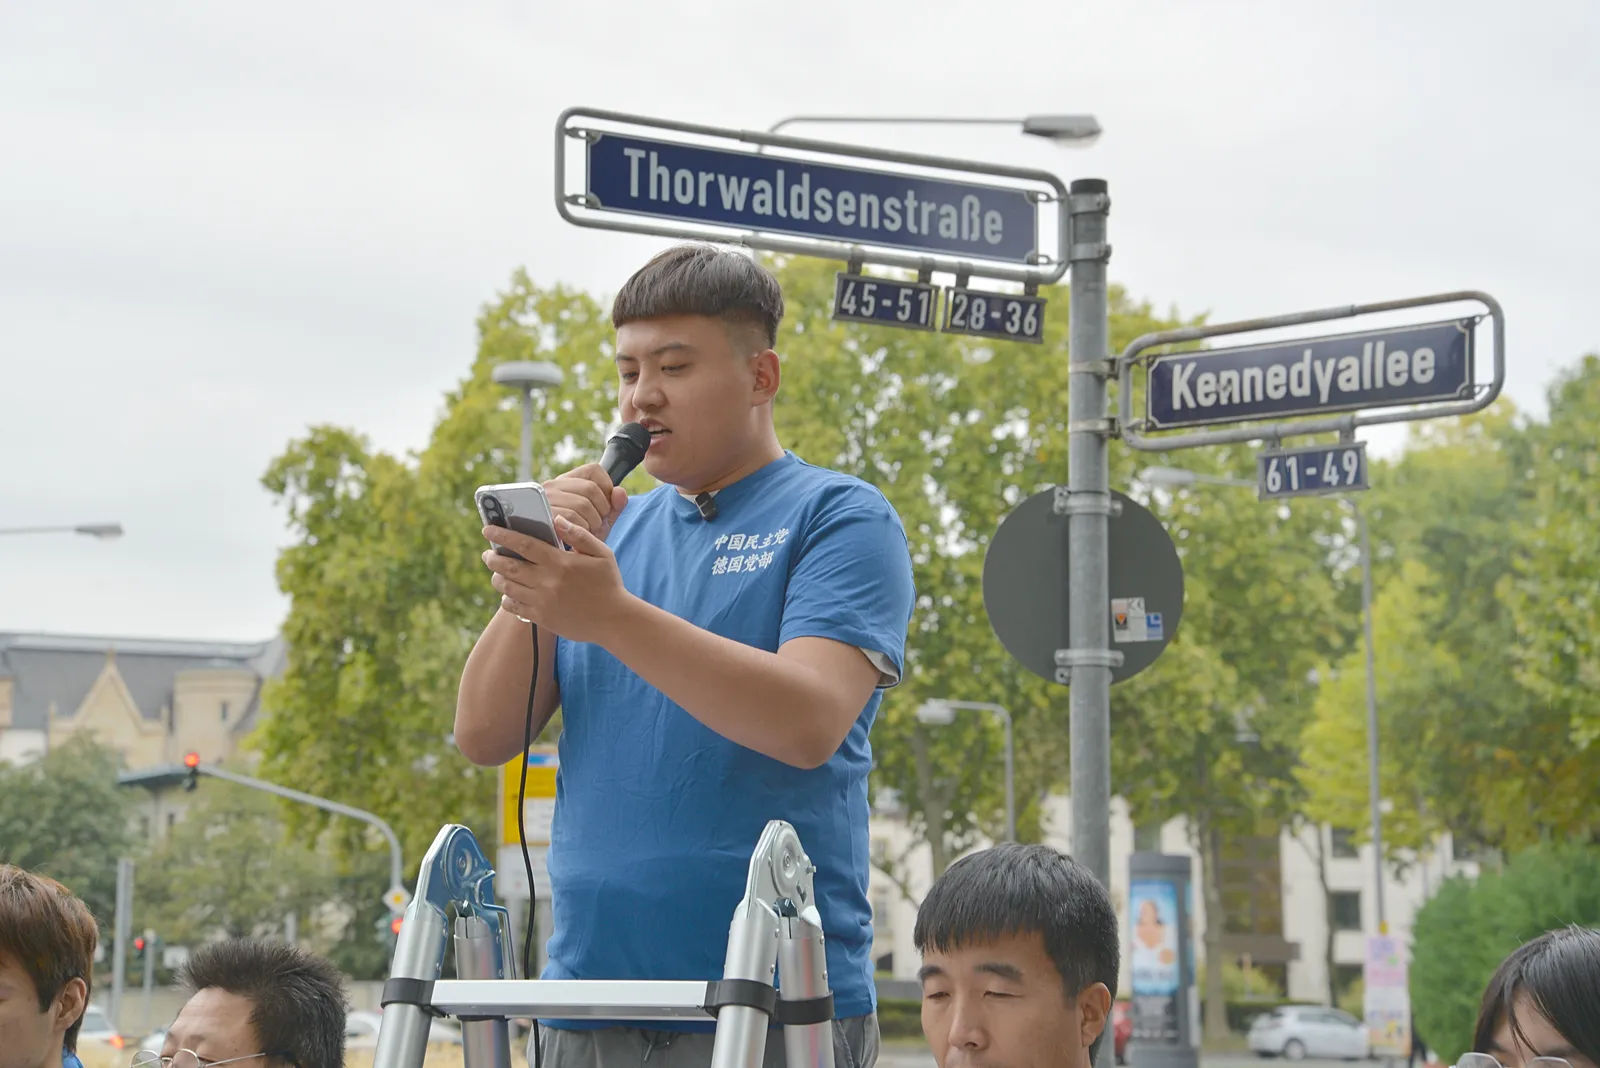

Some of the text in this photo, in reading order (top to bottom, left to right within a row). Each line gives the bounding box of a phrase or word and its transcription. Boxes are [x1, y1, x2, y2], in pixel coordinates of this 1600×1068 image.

[623, 148, 1003, 244] Thorwaldsenstraße
[841, 281, 929, 325] 45-51
[951, 294, 1038, 336] 28-36
[1171, 341, 1435, 410] Kennedyallee
[1266, 450, 1359, 493] 61-49
[714, 528, 789, 551] 中国民主党
[711, 551, 774, 575] 德国党部
